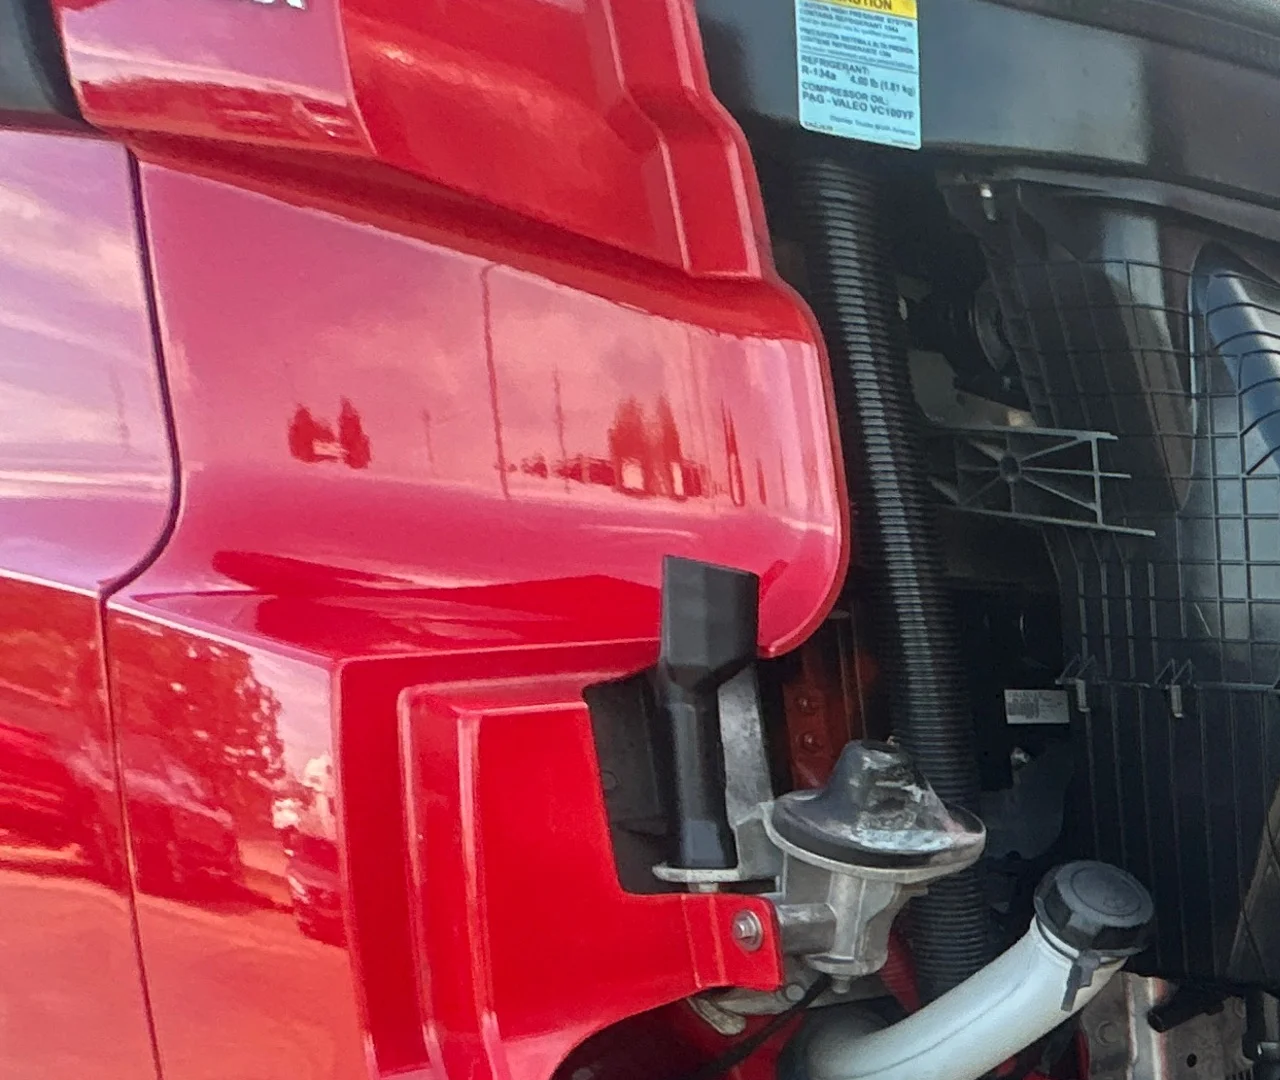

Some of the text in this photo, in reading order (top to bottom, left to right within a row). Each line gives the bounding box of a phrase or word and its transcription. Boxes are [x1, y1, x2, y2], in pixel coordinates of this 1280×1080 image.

[801, 55, 870, 75] REFRIGERANT:
[801, 65, 837, 81] R-134a
[870, 77, 878, 88] lb
[802, 81, 868, 102] COMPRESSOR
[802, 91, 825, 105] PAG
[832, 97, 868, 112] VALEO
